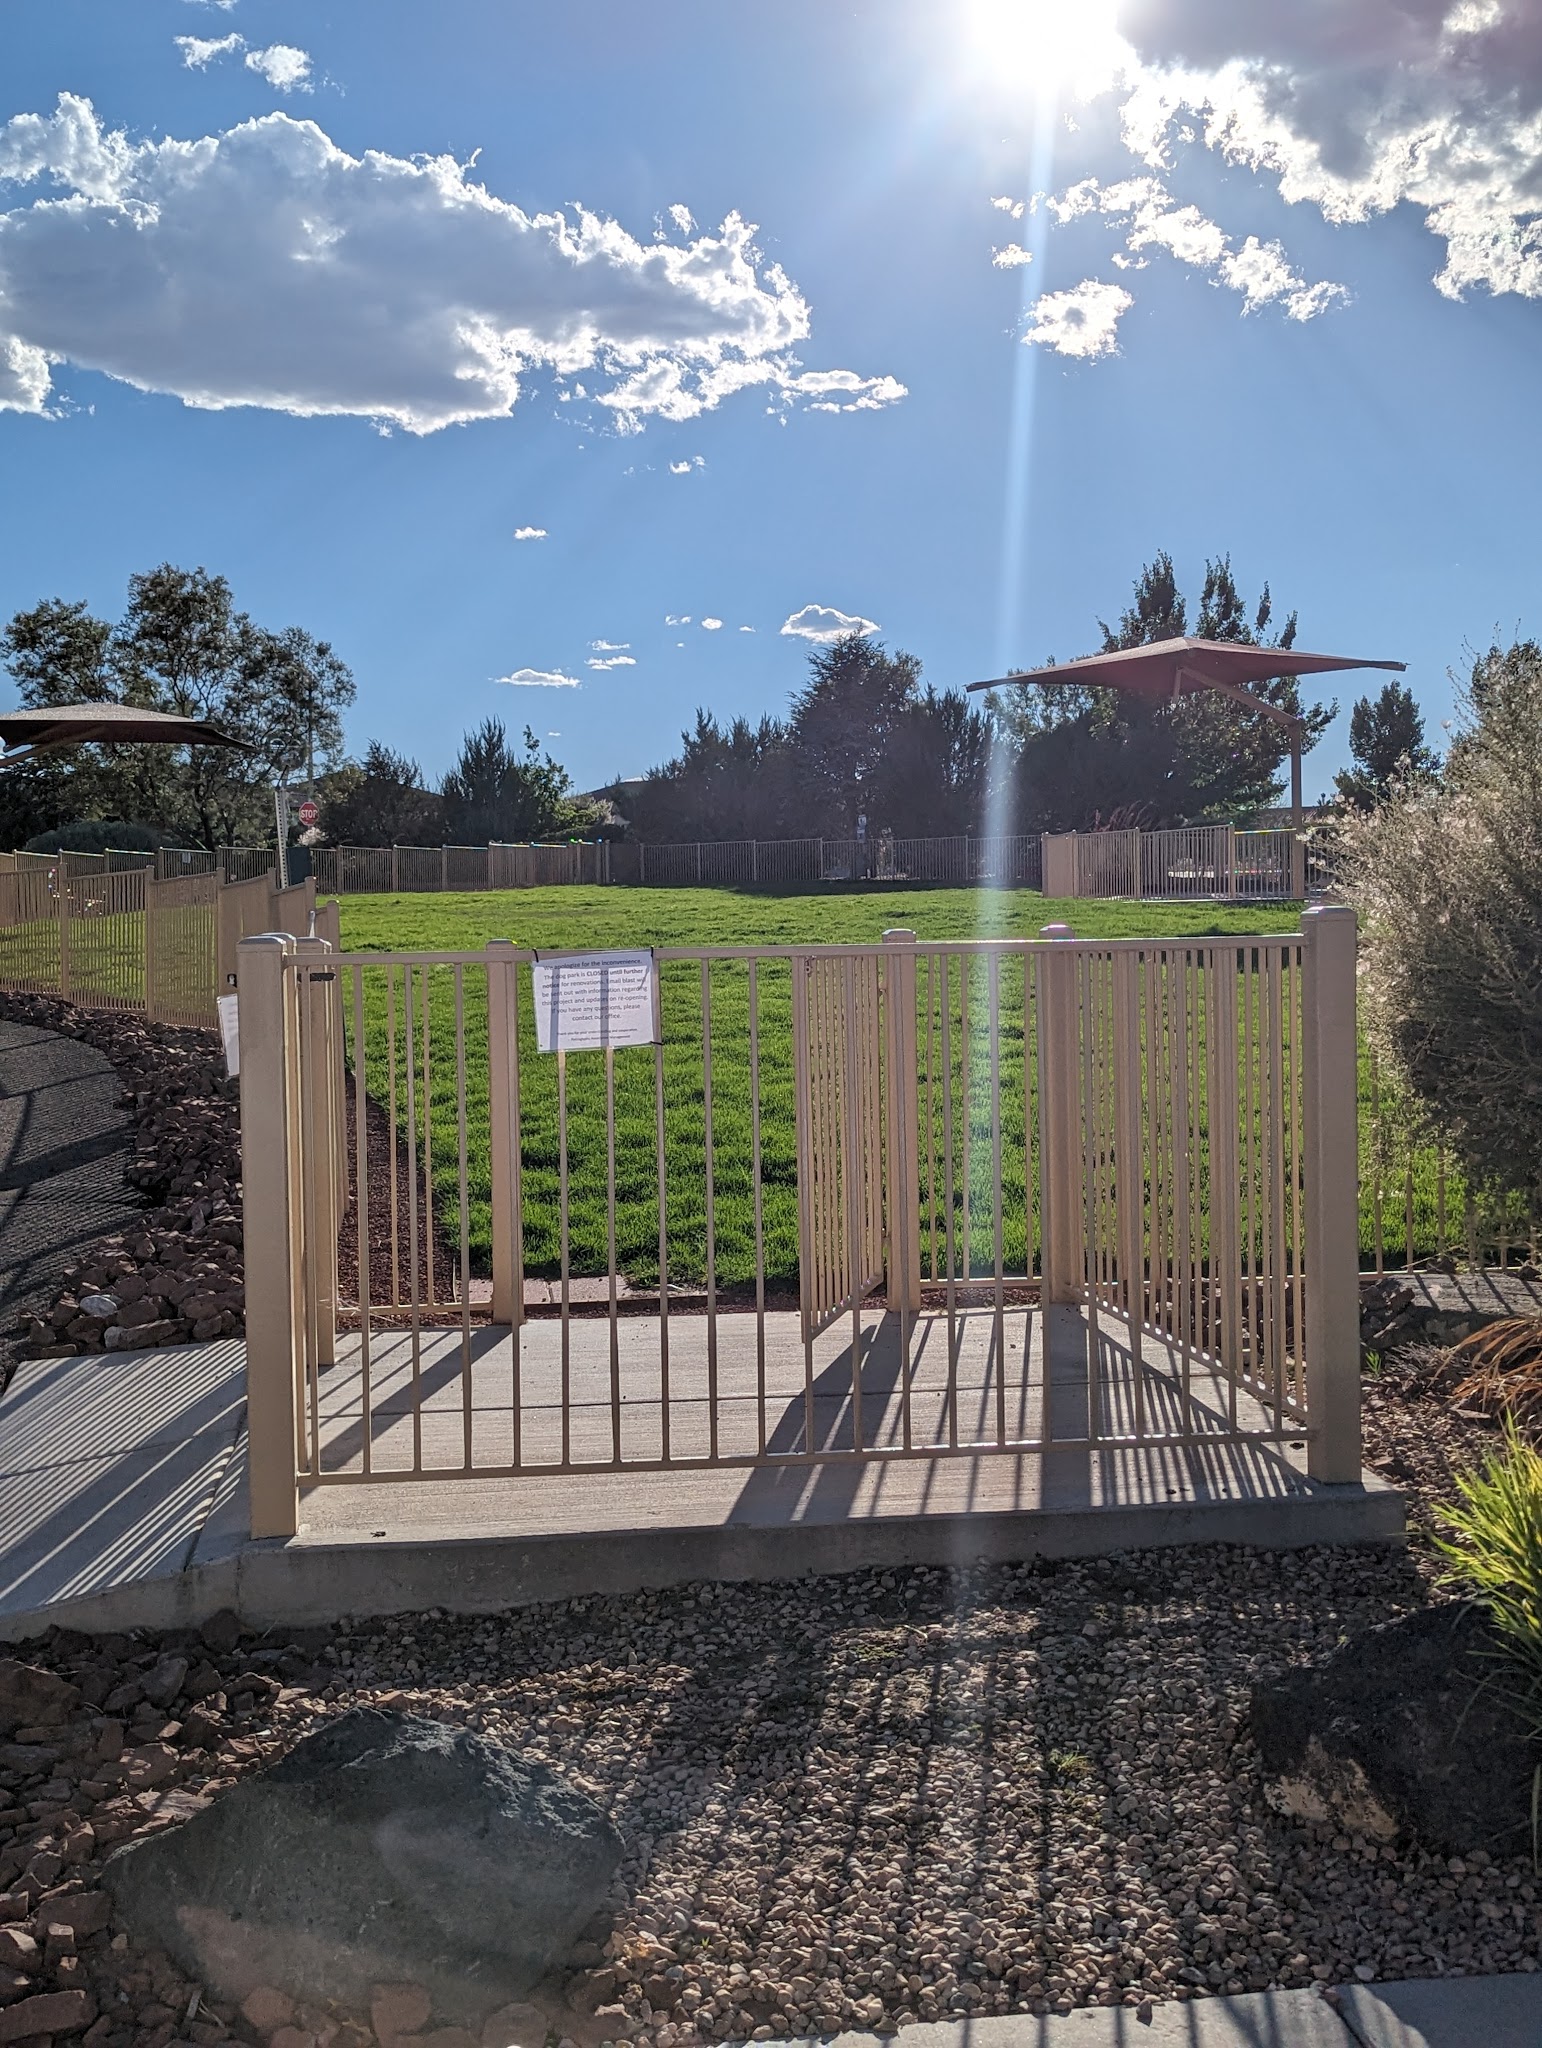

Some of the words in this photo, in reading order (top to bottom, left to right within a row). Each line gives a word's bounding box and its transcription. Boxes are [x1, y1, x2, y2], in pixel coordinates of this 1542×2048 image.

[300, 809, 318, 819] STOP
[554, 962, 580, 970] apologize
[588, 986, 621, 994] information
[553, 998, 573, 1006] project
